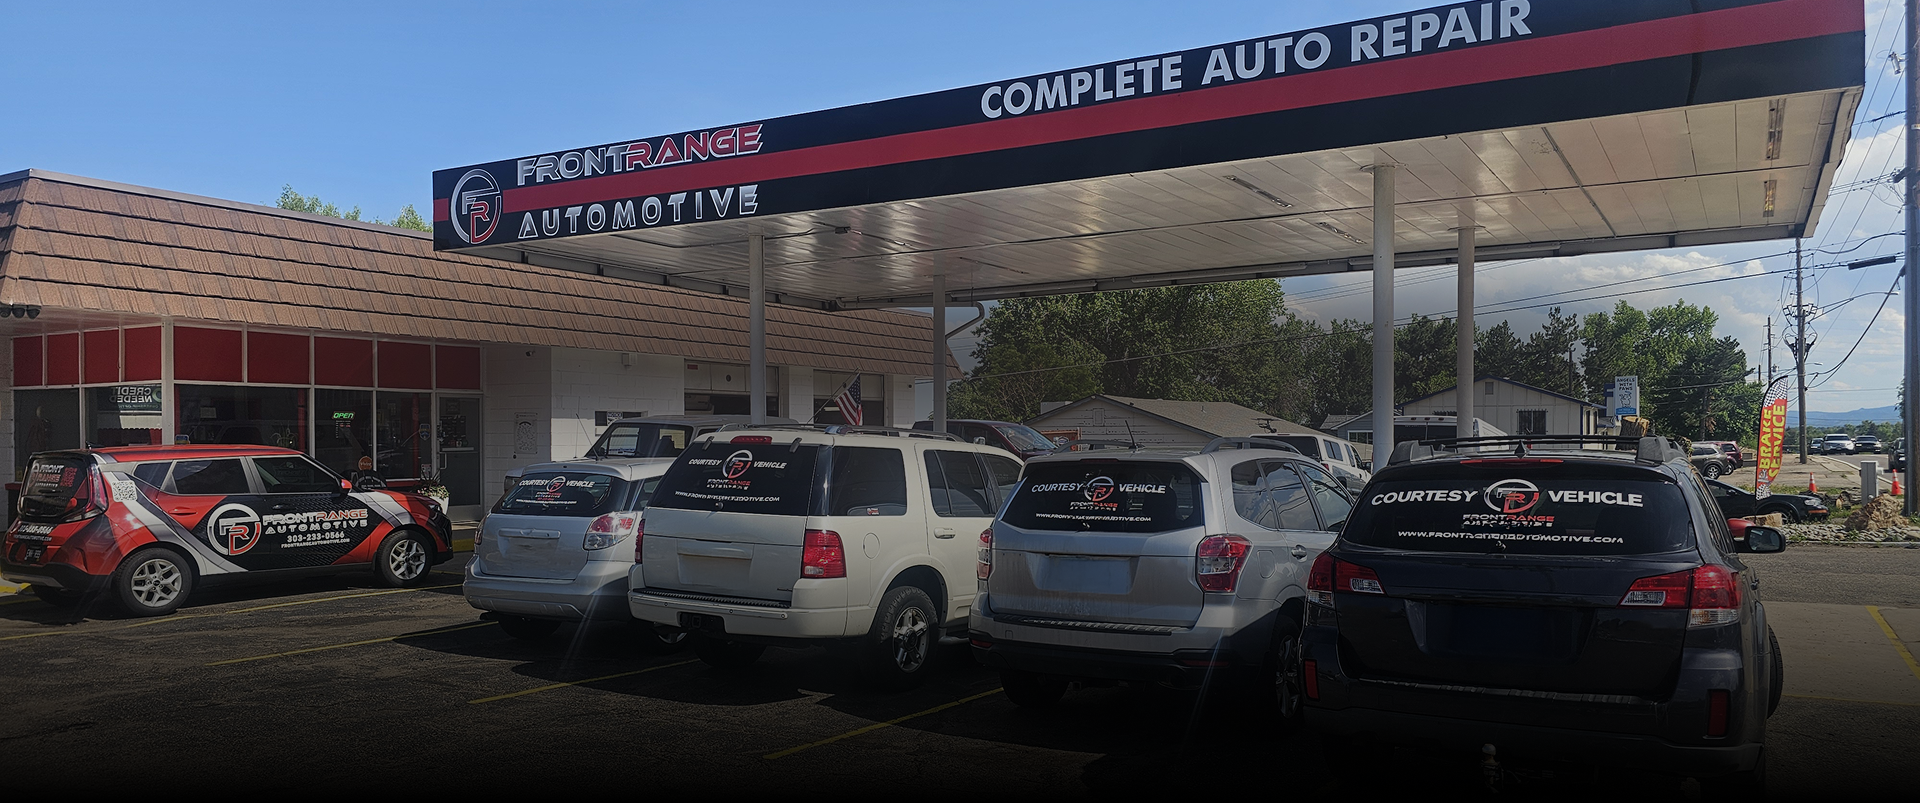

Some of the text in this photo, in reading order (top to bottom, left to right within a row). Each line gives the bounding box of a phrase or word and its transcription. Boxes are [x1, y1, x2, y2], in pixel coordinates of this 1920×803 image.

[980, 0, 1533, 119] COMPLETE AUTO REPAIR
[517, 123, 764, 186] FRONTRANGE
[518, 184, 759, 240] AUTOMOTIVE
[1759, 409, 1772, 470] BRAKE
[1768, 404, 1786, 478] SERVICE
[688, 458, 787, 469] COURTESY VEHICLE
[519, 479, 595, 488] COURTESY VEHICLE
[1031, 483, 1166, 494] COURTESY VEHICLE
[1371, 489, 1643, 507] COURTESY VEHICLE
[262, 508, 368, 526] FRONTRANGE
[1462, 513, 1555, 522] FRONTRANGE
[265, 519, 368, 535] AUTOMOTIVE
[287, 530, 345, 543] 303-233-0566
